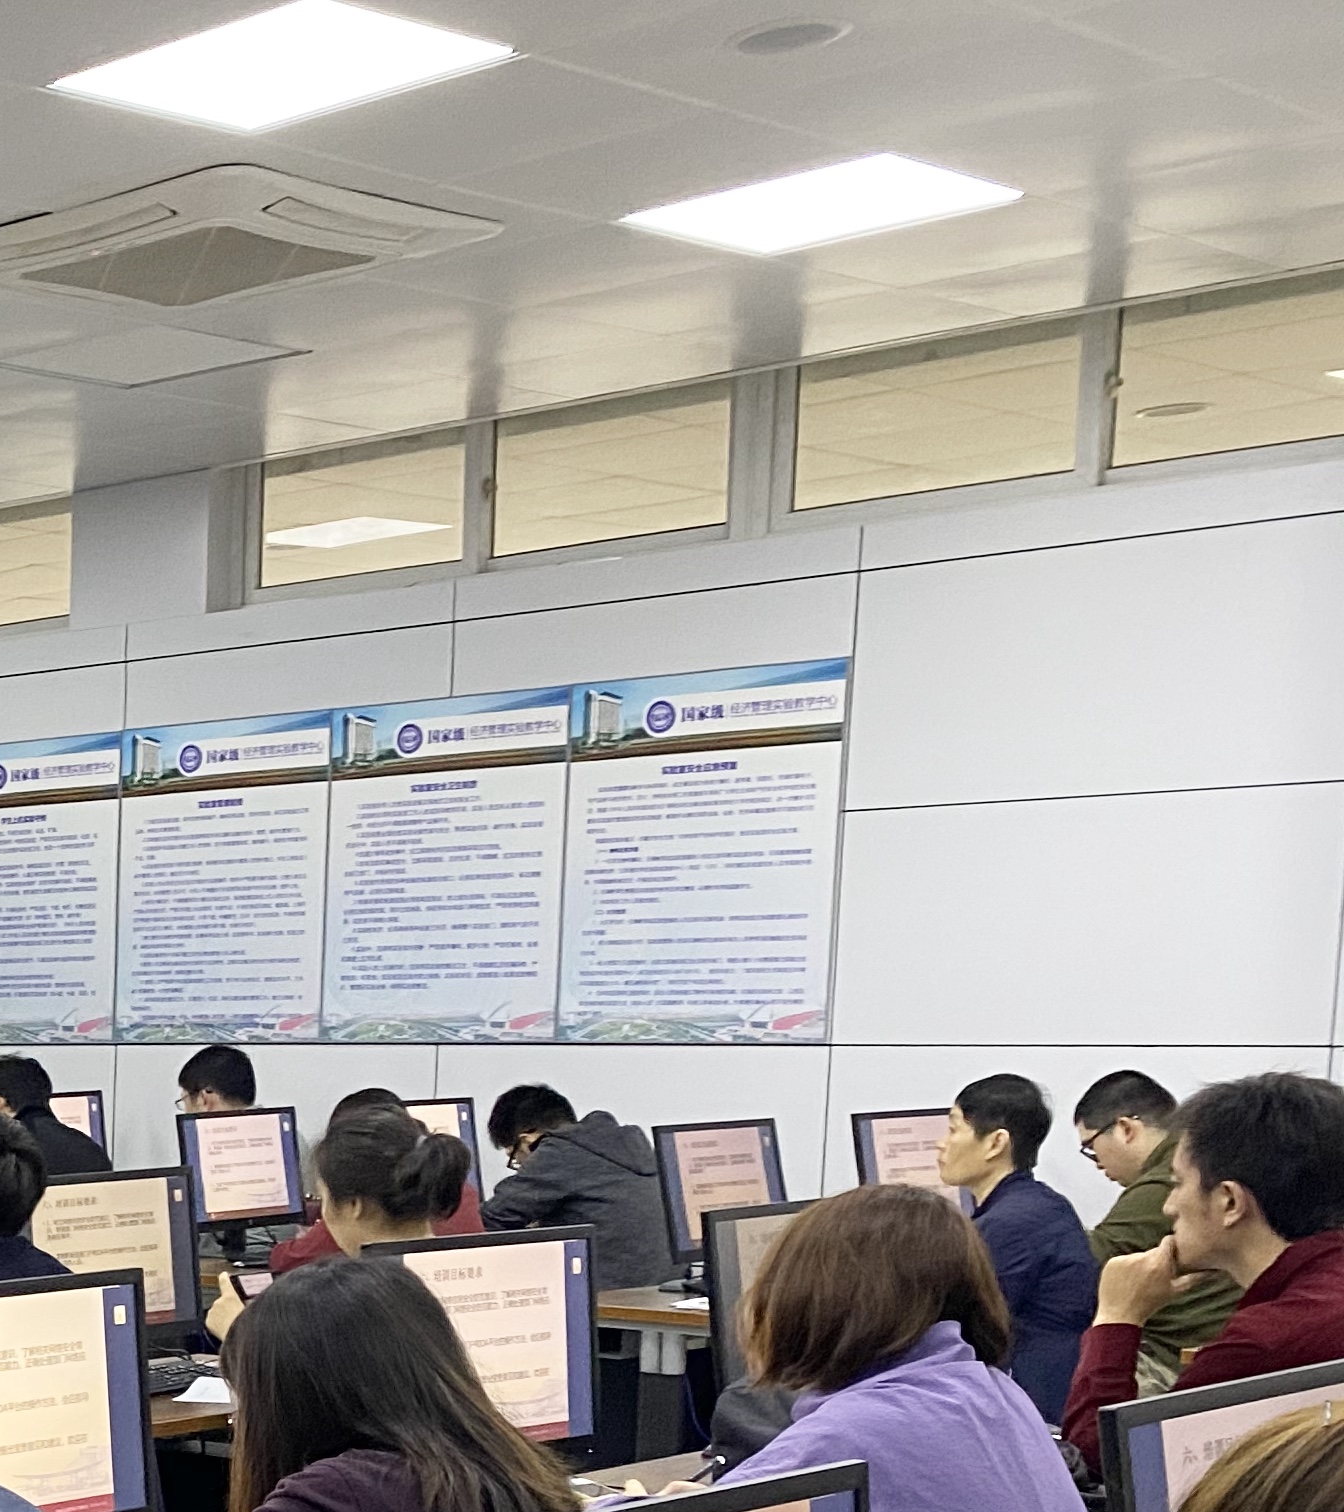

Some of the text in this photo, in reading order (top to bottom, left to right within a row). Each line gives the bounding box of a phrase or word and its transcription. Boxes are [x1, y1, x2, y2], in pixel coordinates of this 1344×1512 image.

[681, 704, 724, 724] 国家级
[428, 727, 465, 745] 国家级
